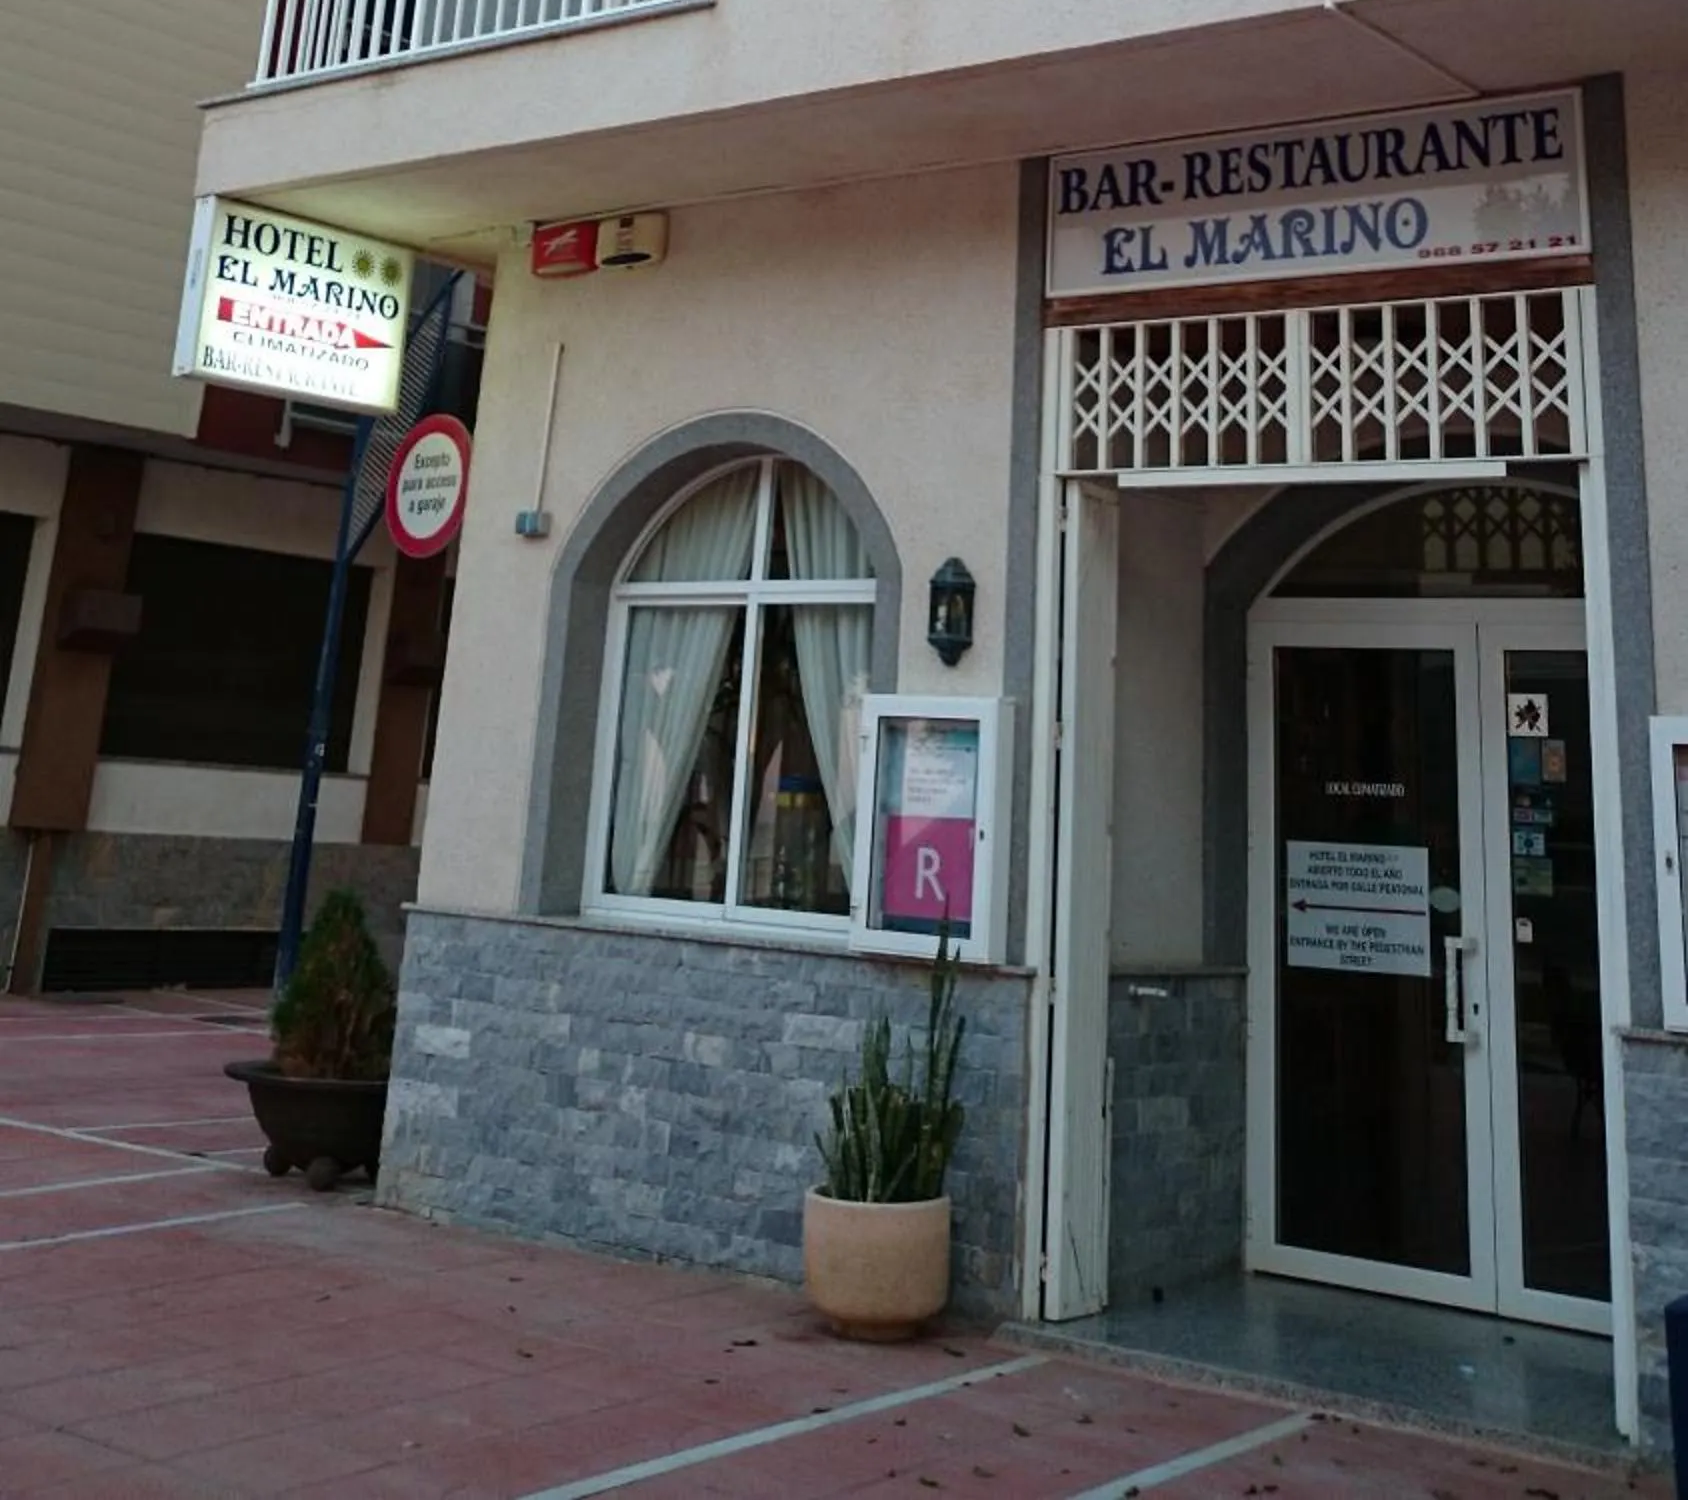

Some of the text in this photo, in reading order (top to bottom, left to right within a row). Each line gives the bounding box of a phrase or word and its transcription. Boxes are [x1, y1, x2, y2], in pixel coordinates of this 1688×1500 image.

[1057, 107, 1565, 216] BAR-RESTAURANTE
[222, 214, 344, 273] HOTEL
[1102, 197, 1428, 275] EL MARINO
[1472, 241, 1498, 254] 57
[1509, 238, 1536, 250] 21
[1548, 234, 1576, 248] 21
[217, 255, 257, 287] EL
[268, 267, 399, 320] MARINO
[232, 299, 352, 349] ENTRADA
[233, 330, 369, 371] CLIMATIZADO
[914, 847, 945, 902] R
